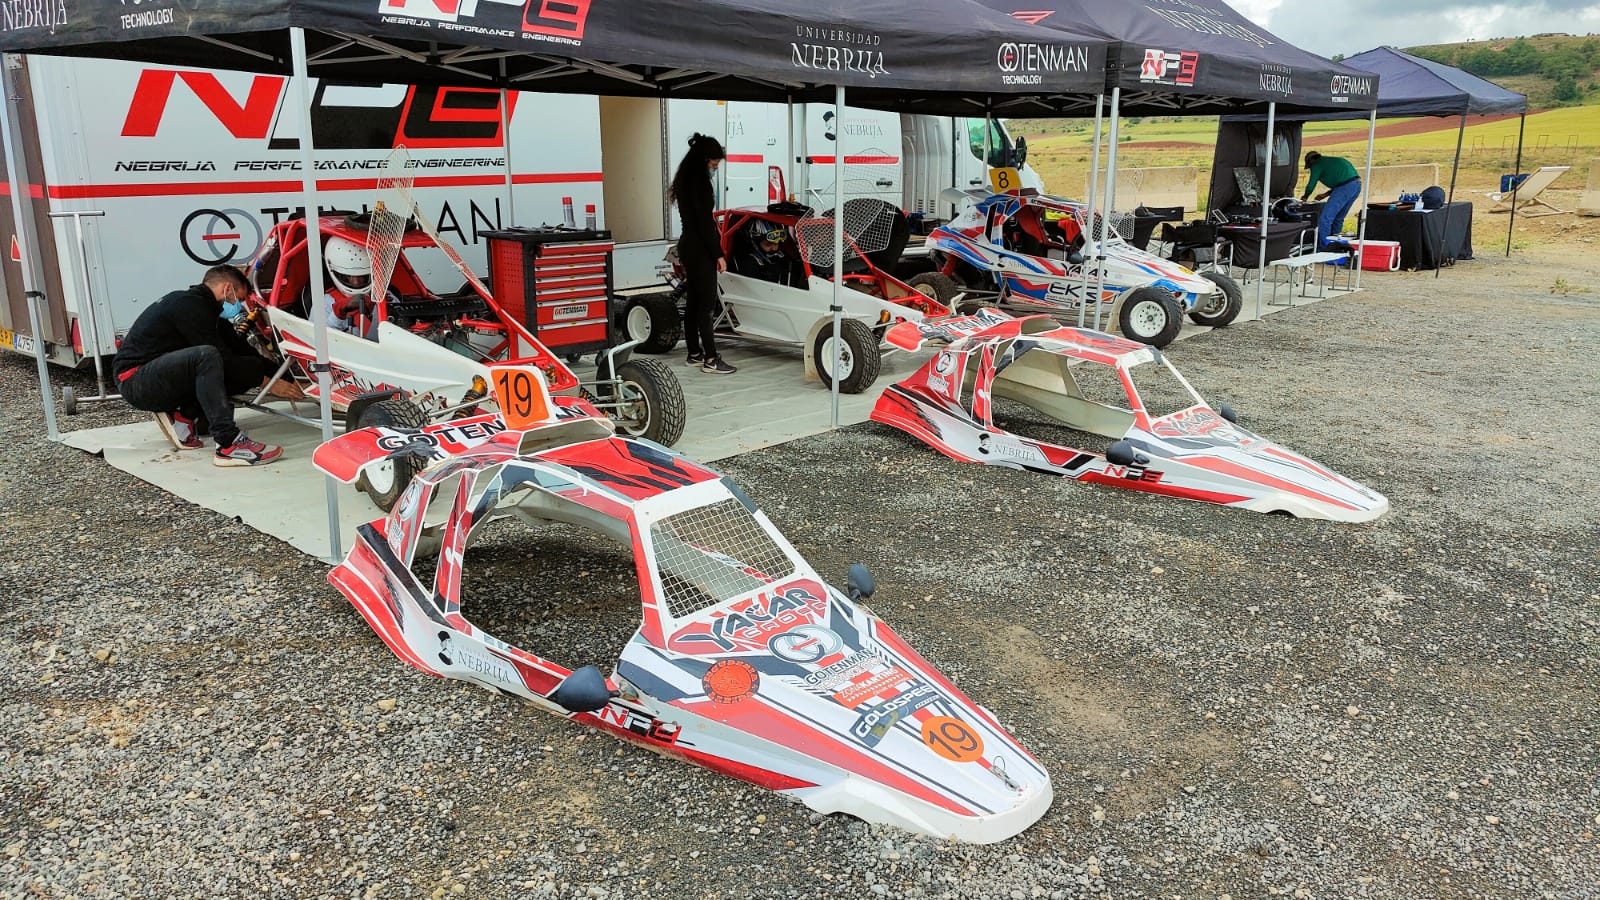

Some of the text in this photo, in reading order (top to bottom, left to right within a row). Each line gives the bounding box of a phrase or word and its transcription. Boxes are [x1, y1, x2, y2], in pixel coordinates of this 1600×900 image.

[2, 0, 68, 35] NEBRIJA
[381, 15, 431, 28] NEBRIJA
[437, 22, 515, 38] PERFORMANCE
[521, 32, 582, 47] ENGINEERING
[796, 25, 881, 46] UNIVERSIDAD
[790, 42, 892, 79] NEBRIJA
[1259, 73, 1294, 98] NEBRIJA
[115, 160, 217, 172] NEBRIJA
[998, 171, 1010, 189] 8
[500, 371, 532, 417] 19
[994, 444, 1037, 461] NEBRIJA
[674, 587, 820, 651] YACAR
[457, 649, 512, 684] NEBRIJA
[804, 647, 875, 685] GOTENMAN
[929, 722, 978, 758] 19
